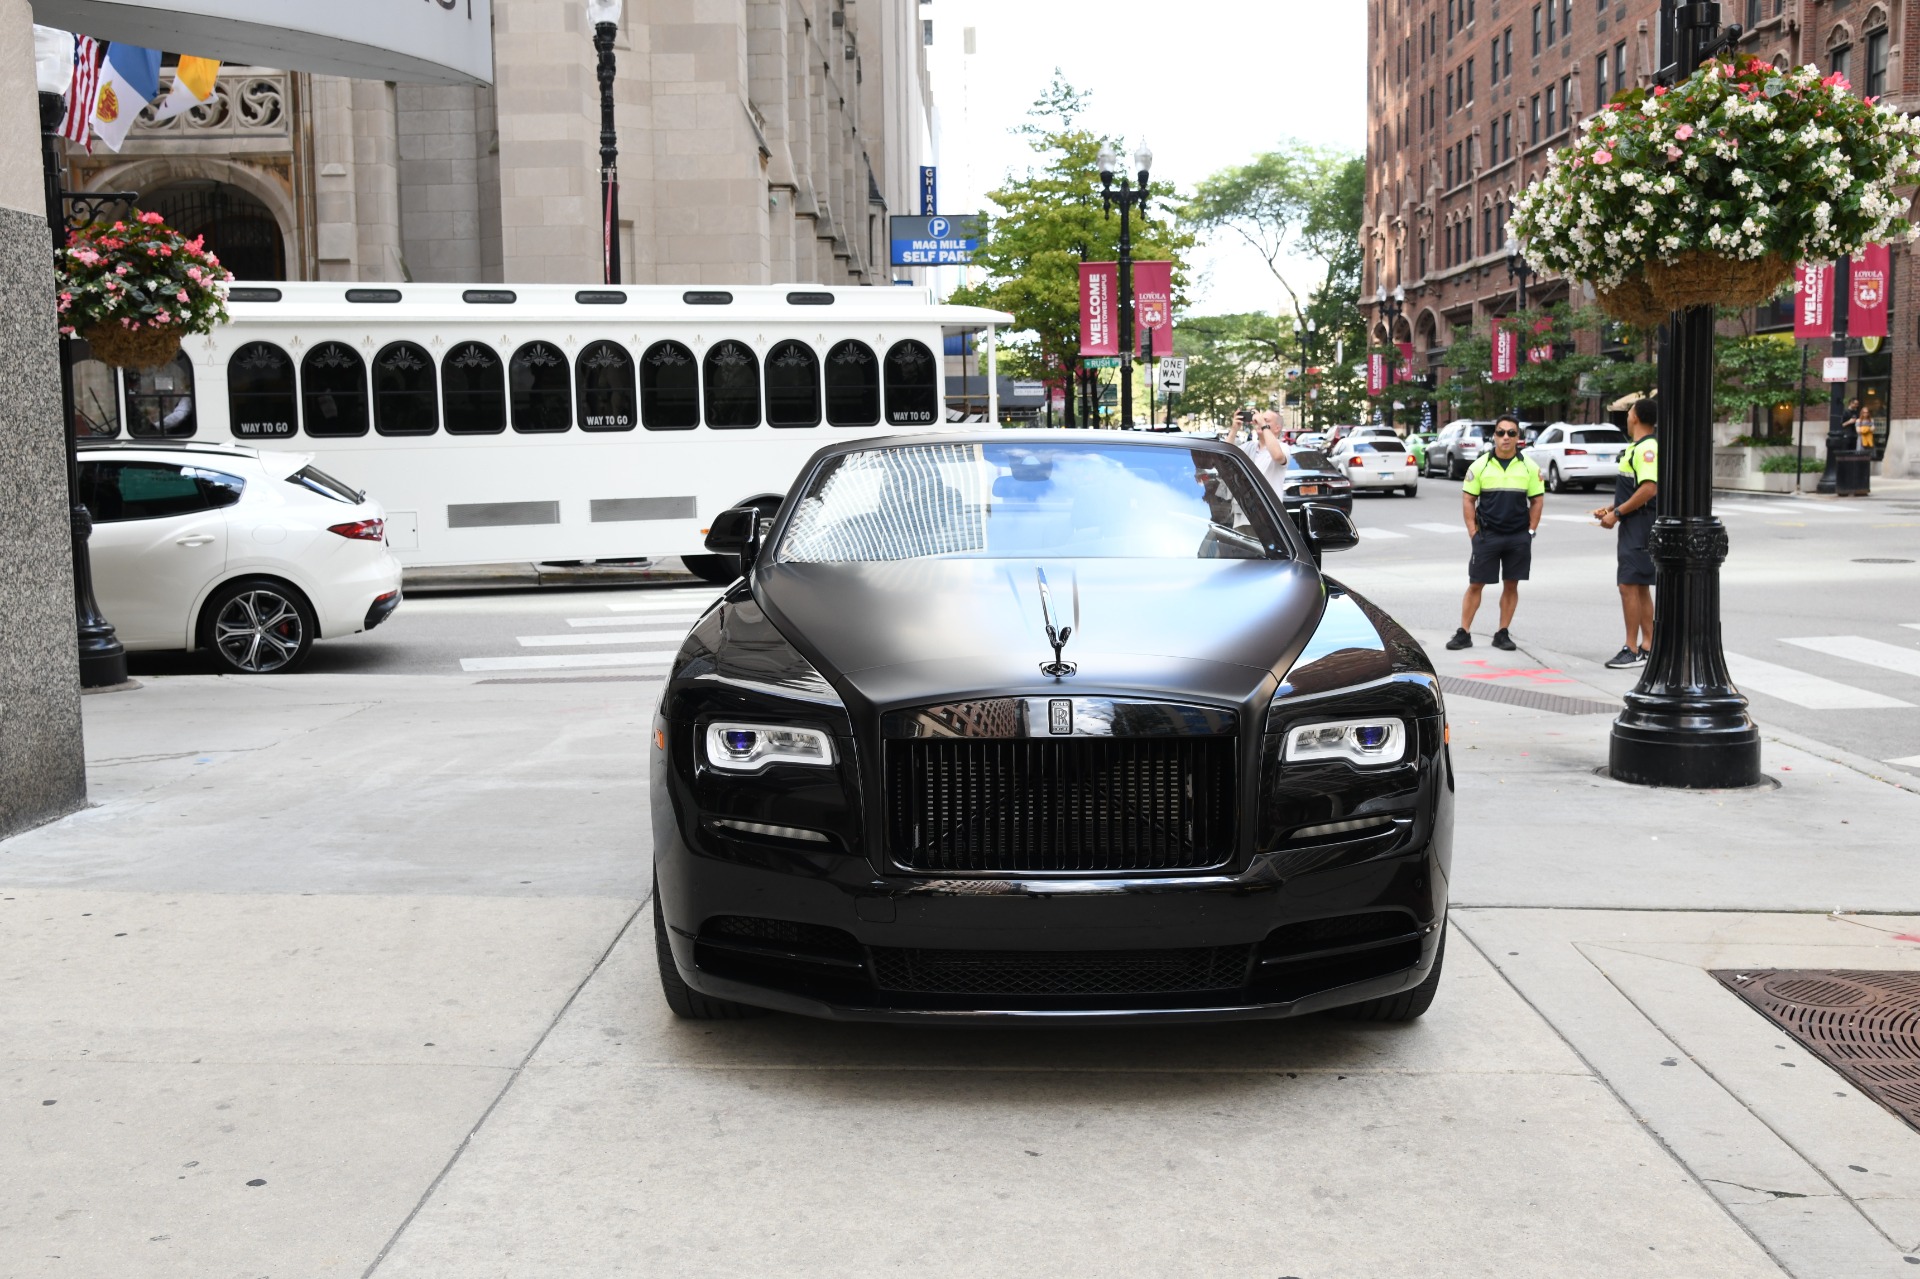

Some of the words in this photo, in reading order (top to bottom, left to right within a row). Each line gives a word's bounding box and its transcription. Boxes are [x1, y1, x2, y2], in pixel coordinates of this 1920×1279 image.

[925, 168, 934, 215] GHIRA
[933, 220, 946, 236] P
[912, 240, 938, 250] MAG
[940, 240, 967, 249] MILE
[902, 251, 936, 263] SELF
[1854, 270, 1883, 278] LOYOLA
[1138, 292, 1167, 300] LOYOLA
[1804, 262, 1817, 326] WELCOM
[1089, 273, 1101, 346] WELCOME
[1091, 359, 1111, 368] RUSH
[1163, 360, 1182, 368] ONE
[1162, 370, 1182, 379] WAY
[586, 416, 603, 426] WAY
[605, 415, 615, 425] TO
[616, 415, 628, 425] GO
[893, 411, 909, 421] WAY
[909, 411, 919, 421] TO
[920, 411, 930, 420] GO
[241, 423, 260, 433] WAY
[262, 422, 273, 433] TO
[275, 422, 288, 432] GO
